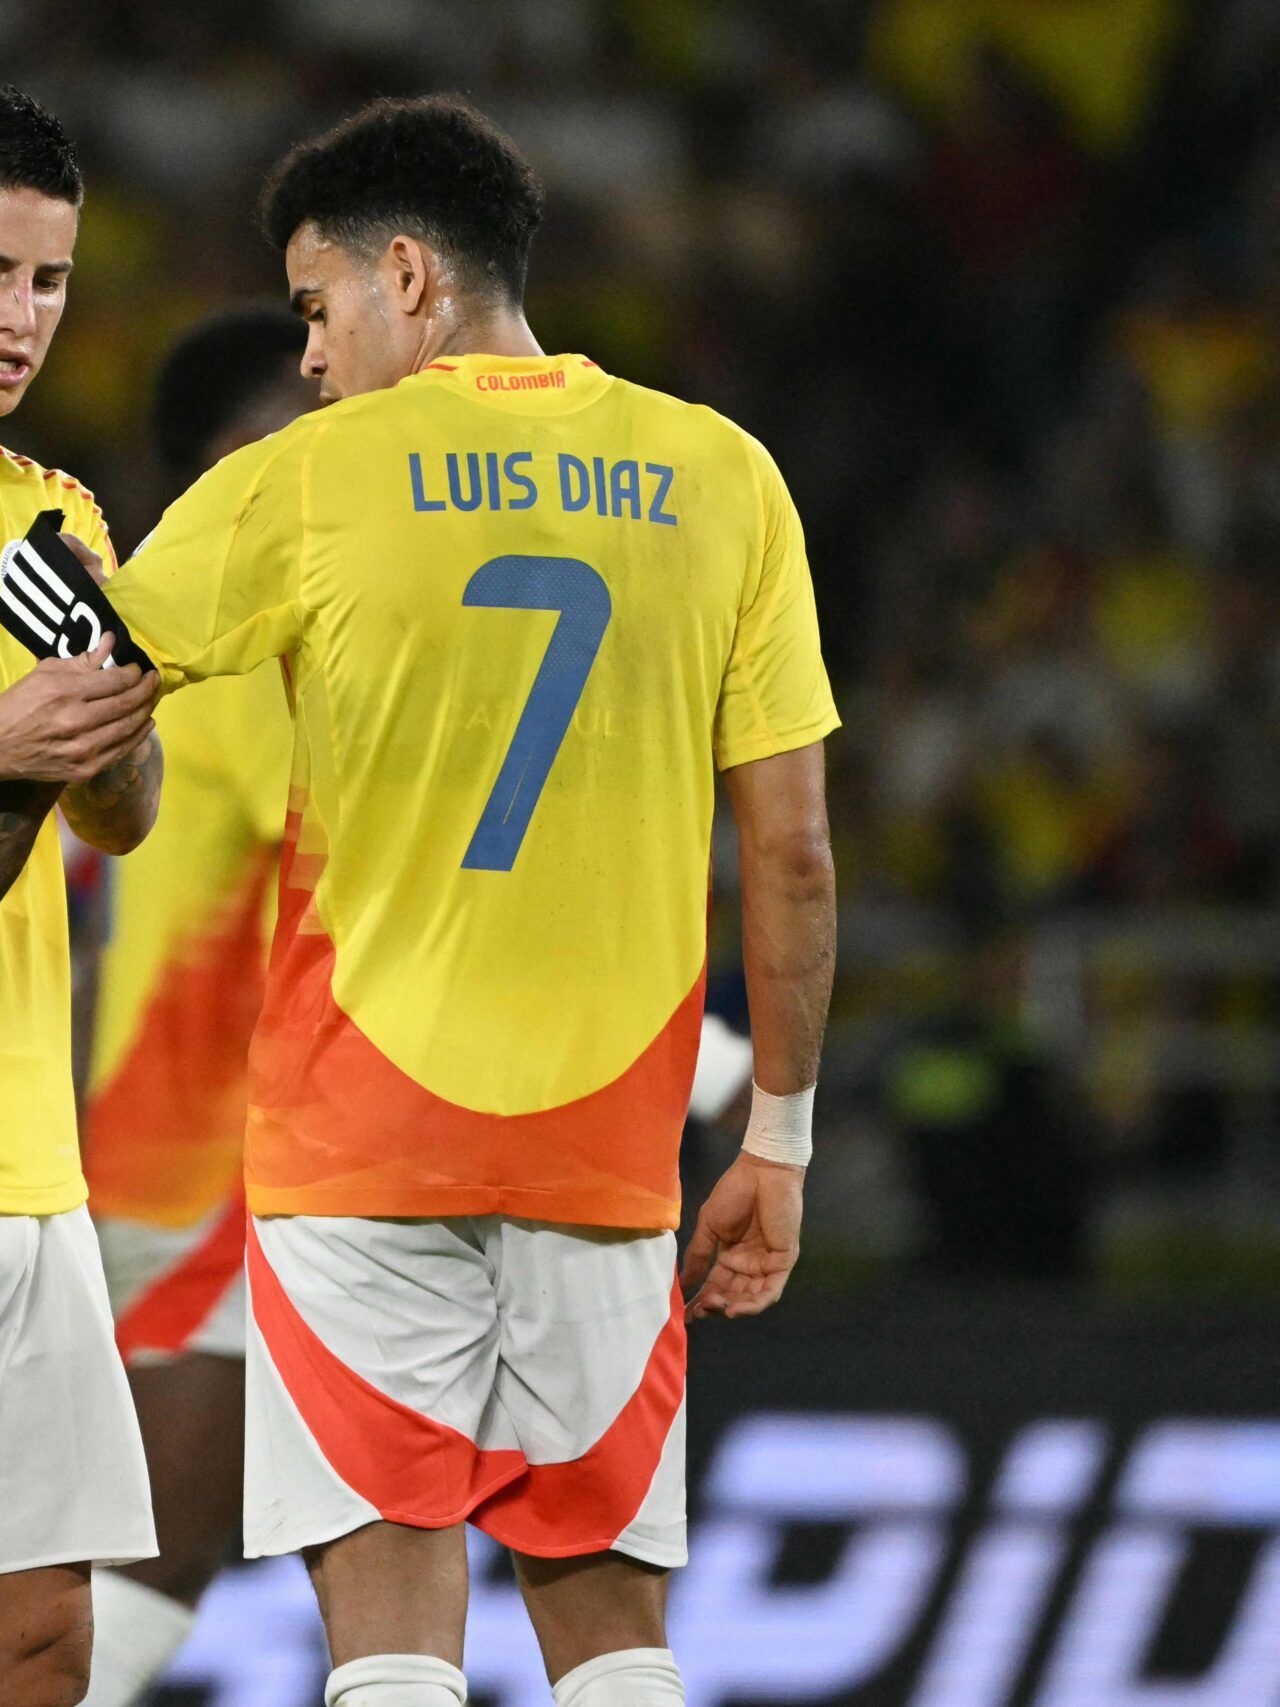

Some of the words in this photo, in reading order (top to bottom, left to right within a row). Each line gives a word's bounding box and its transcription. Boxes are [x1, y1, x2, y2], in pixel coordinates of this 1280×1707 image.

[476, 370, 565, 391] COLOMBIA
[409, 451, 538, 512] LUIS
[558, 453, 677, 526] DIAZ
[460, 555, 612, 872] 7
